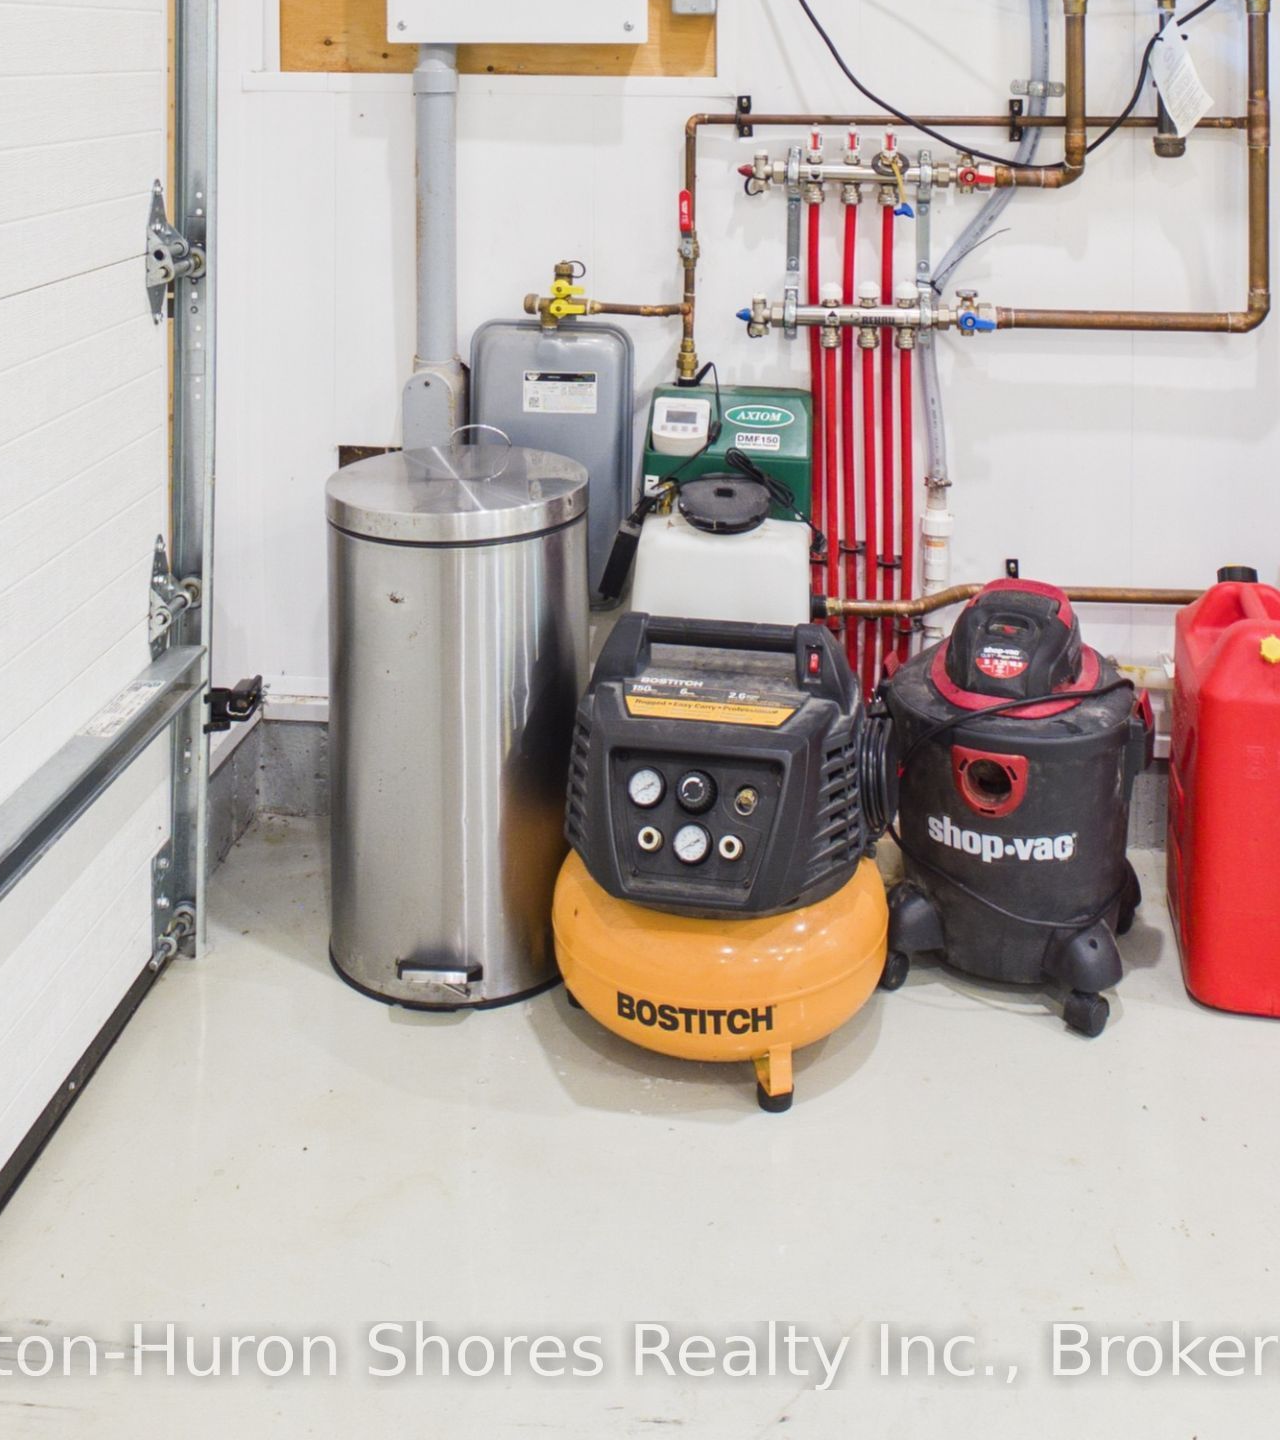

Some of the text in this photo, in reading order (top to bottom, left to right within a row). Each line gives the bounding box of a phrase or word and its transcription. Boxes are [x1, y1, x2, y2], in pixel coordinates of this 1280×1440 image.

[736, 411, 782, 422] AXIOM
[737, 434, 778, 444] DMF150
[641, 677, 704, 688] BOSTITCH
[617, 990, 774, 1035] BOSTITCH
